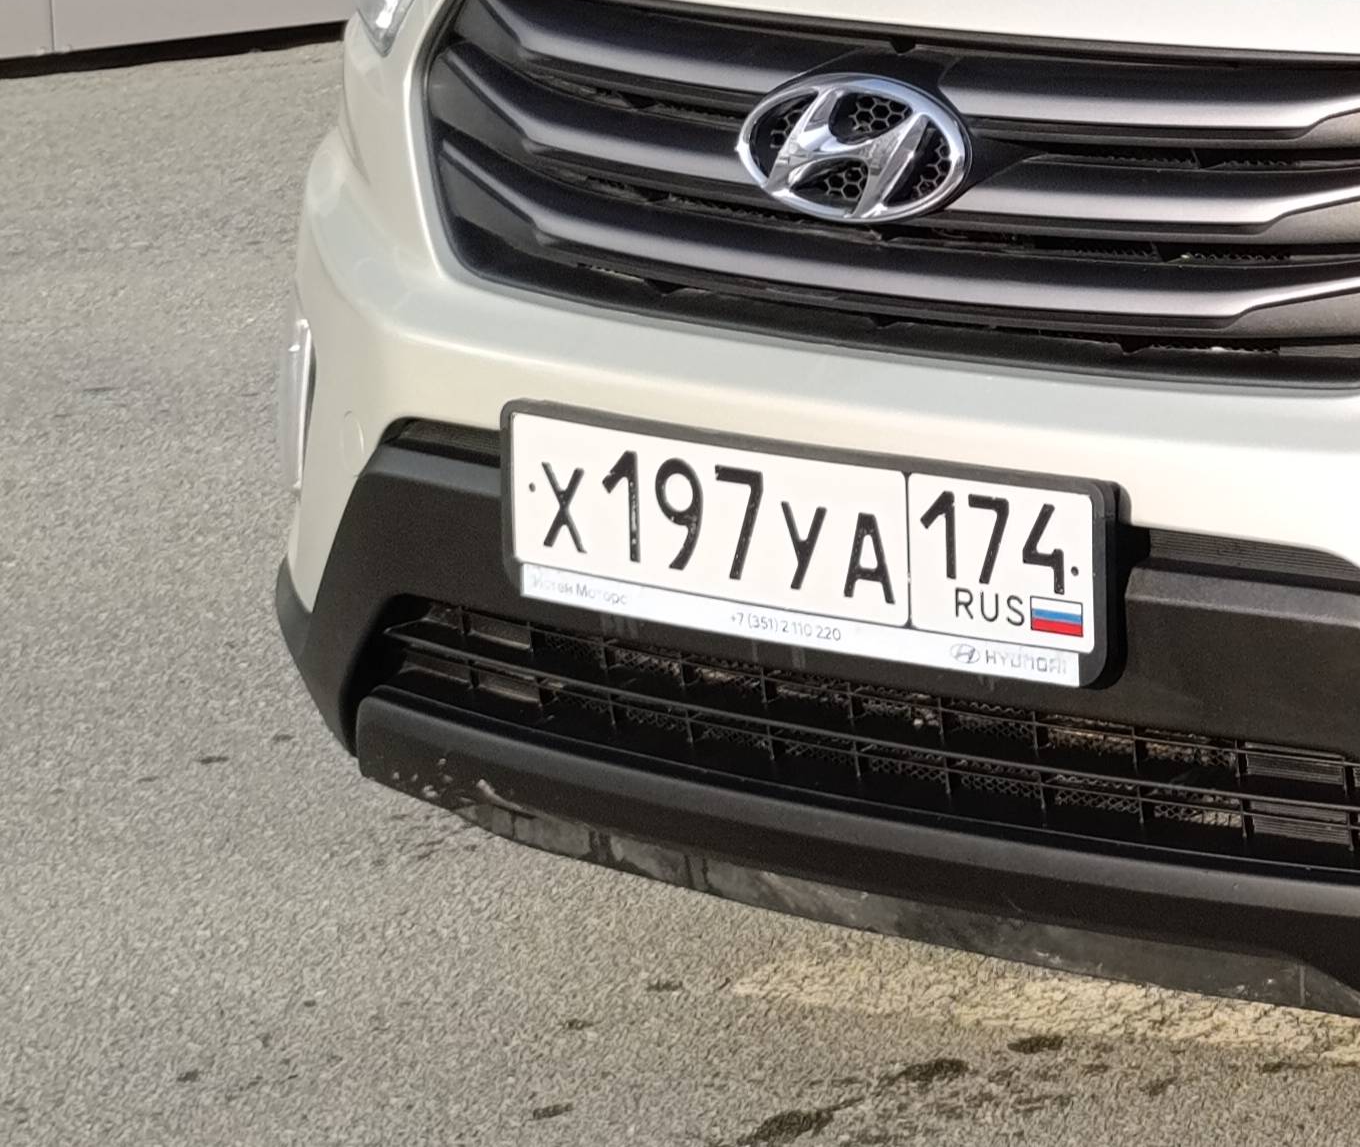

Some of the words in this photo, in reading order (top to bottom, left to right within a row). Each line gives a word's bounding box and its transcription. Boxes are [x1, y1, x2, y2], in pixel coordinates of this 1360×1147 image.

[542, 450, 896, 605] Х197УА
[919, 490, 1066, 595] 174
[747, 612, 779, 633] (351)
[791, 620, 813, 638] 110
[815, 623, 843, 642] 220
[954, 587, 1025, 627] RUS
